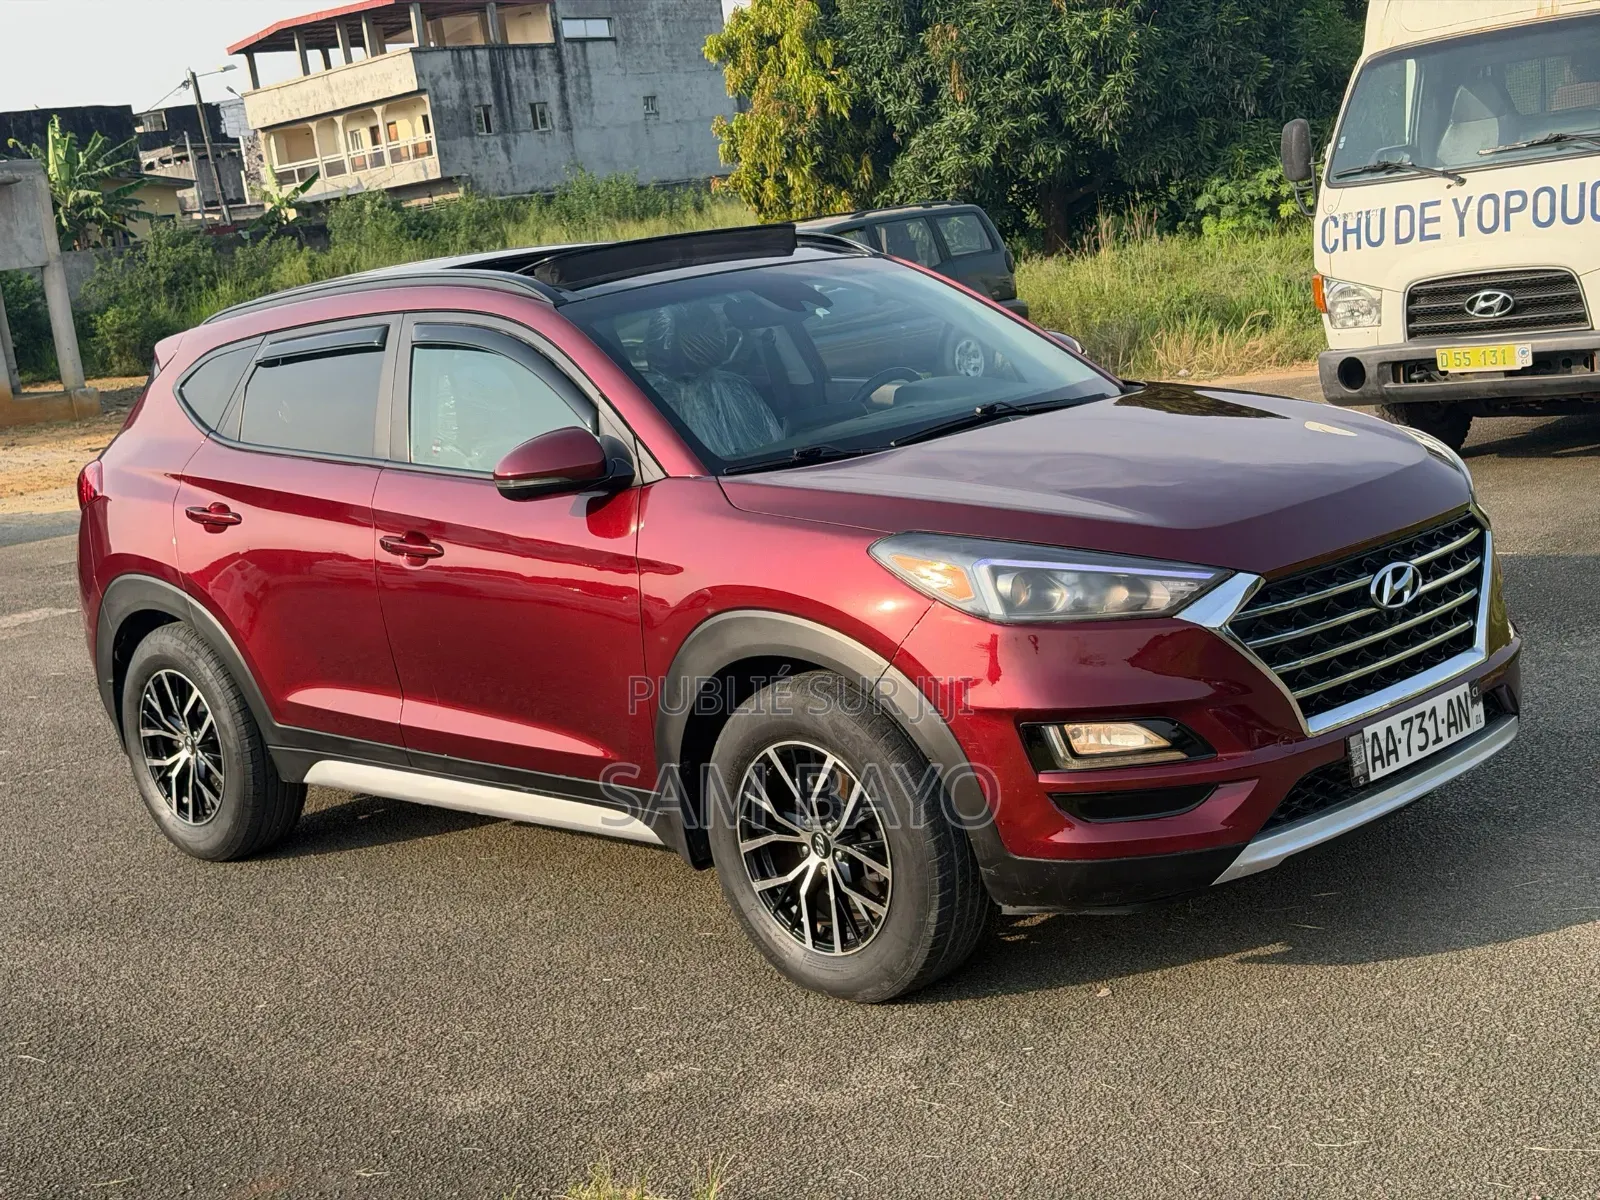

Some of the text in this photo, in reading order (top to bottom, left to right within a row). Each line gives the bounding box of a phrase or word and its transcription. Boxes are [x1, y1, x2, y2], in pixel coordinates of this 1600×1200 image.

[1321, 207, 1386, 254] CHU
[1394, 200, 1442, 245] DE
[1453, 351, 1471, 367] 55
[1480, 349, 1506, 366] 131
